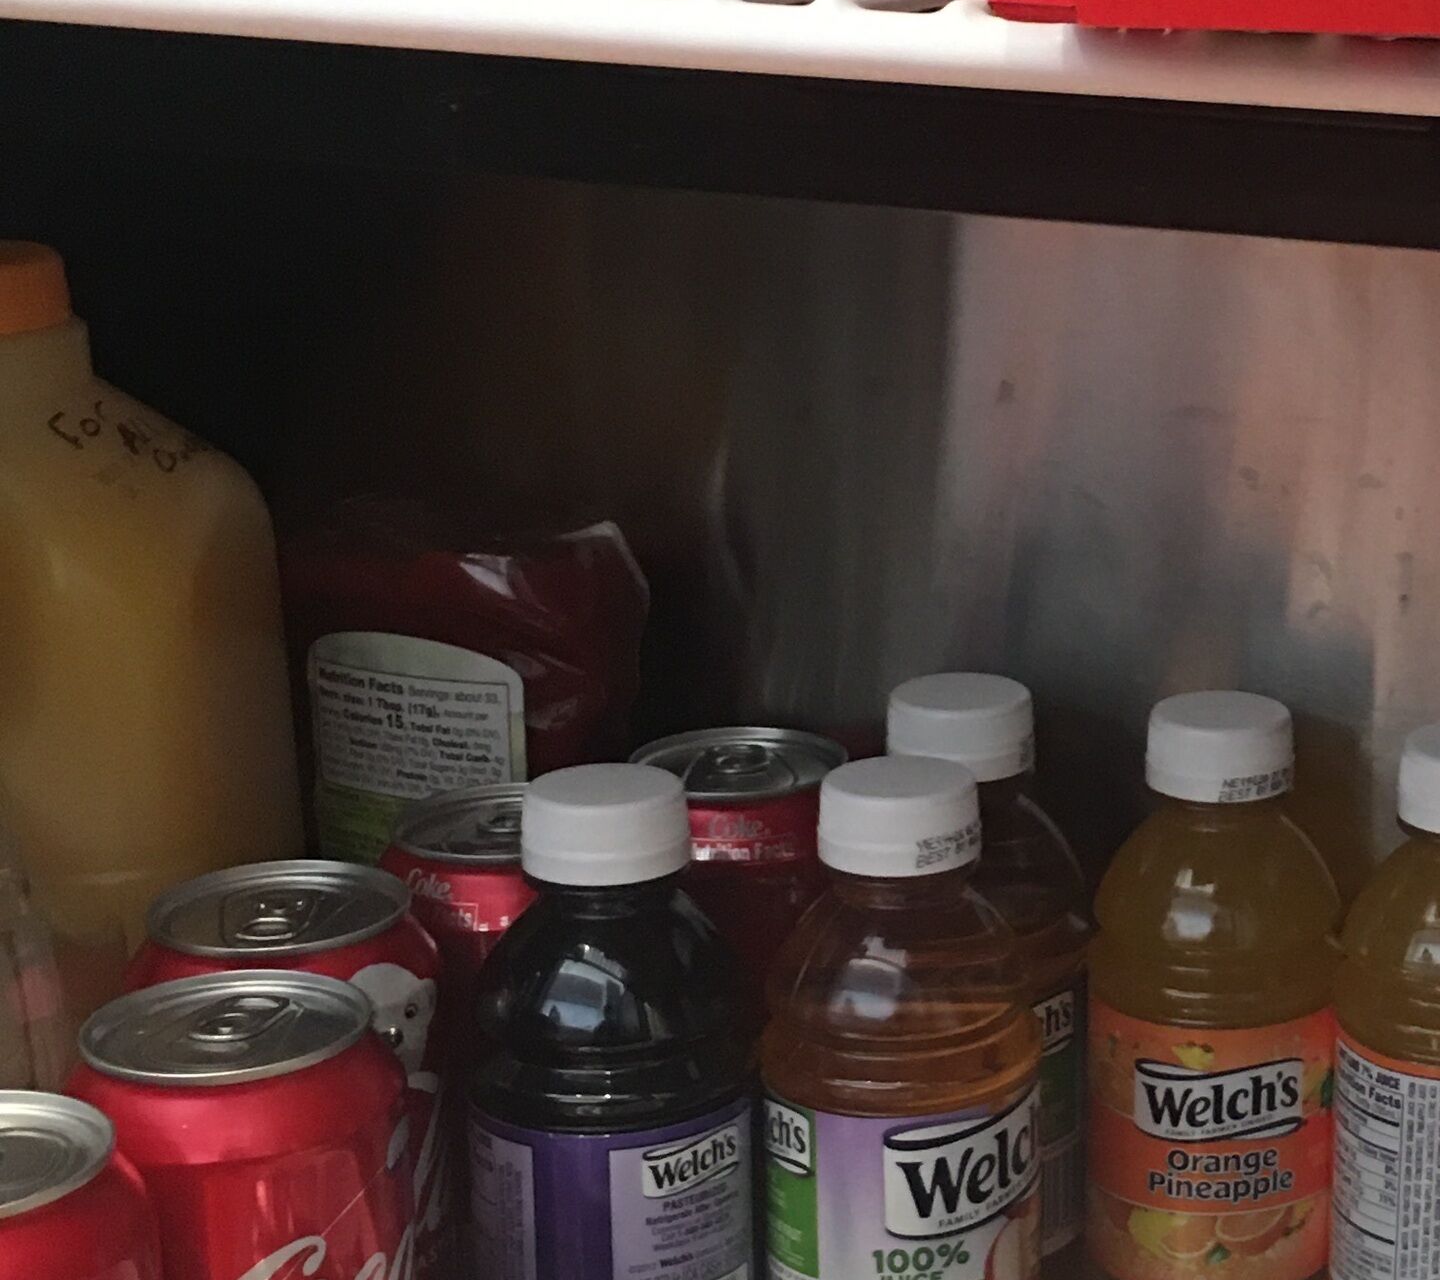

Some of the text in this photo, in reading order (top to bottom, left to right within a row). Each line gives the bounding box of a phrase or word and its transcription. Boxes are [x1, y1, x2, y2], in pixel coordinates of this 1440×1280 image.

[369, 678, 403, 694] Facts
[404, 868, 453, 897] Coke
[1375, 1072, 1401, 1090] JUICE
[1142, 1072, 1299, 1127] Welch's
[1368, 1084, 1401, 1108] Facts
[649, 1134, 736, 1189] Welch's
[1168, 1149, 1277, 1175] Orange
[1149, 1171, 1293, 1202] Pineapple
[938, 1209, 980, 1227] FAMILY
[872, 1240, 971, 1274] 100%
